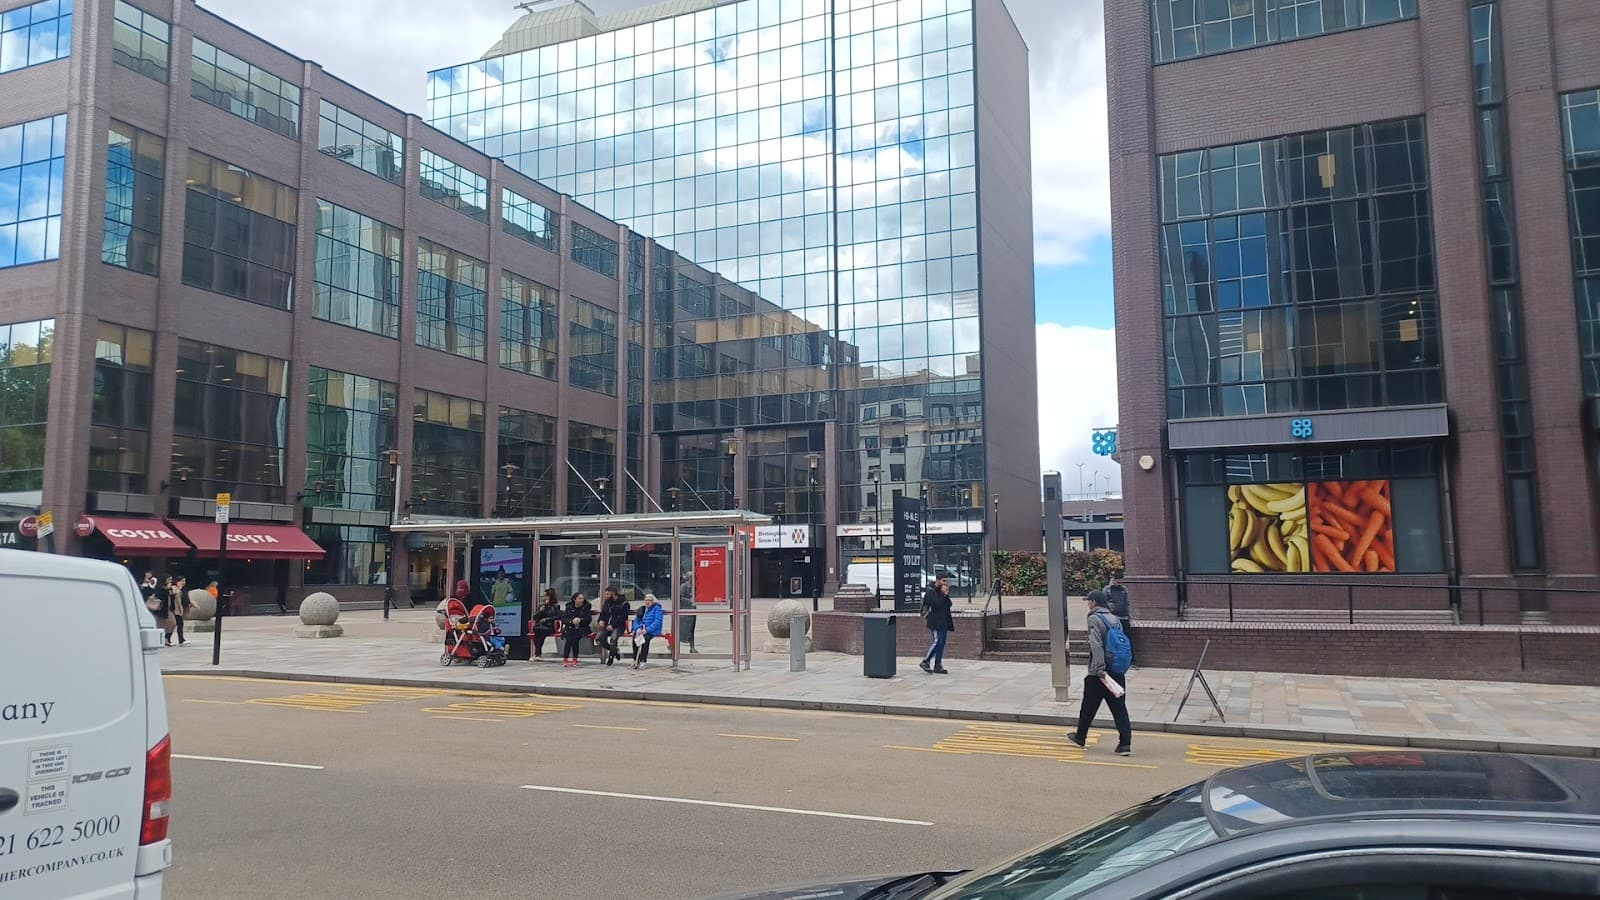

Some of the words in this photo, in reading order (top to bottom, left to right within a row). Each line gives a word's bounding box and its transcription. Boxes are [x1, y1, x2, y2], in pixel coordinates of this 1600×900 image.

[0, 532, 16, 545] TA
[107, 528, 174, 541] COSTA
[226, 534, 279, 544] COSTA
[903, 555, 910, 566] TO
[911, 555, 920, 566] LET
[104, 767, 132, 778] CDI
[30, 792, 56, 801] VEHICLE
[32, 798, 62, 808] TRACKED
[0, 834, 15, 856] 21
[26, 825, 64, 850] 622
[71, 814, 120, 842] 5000
